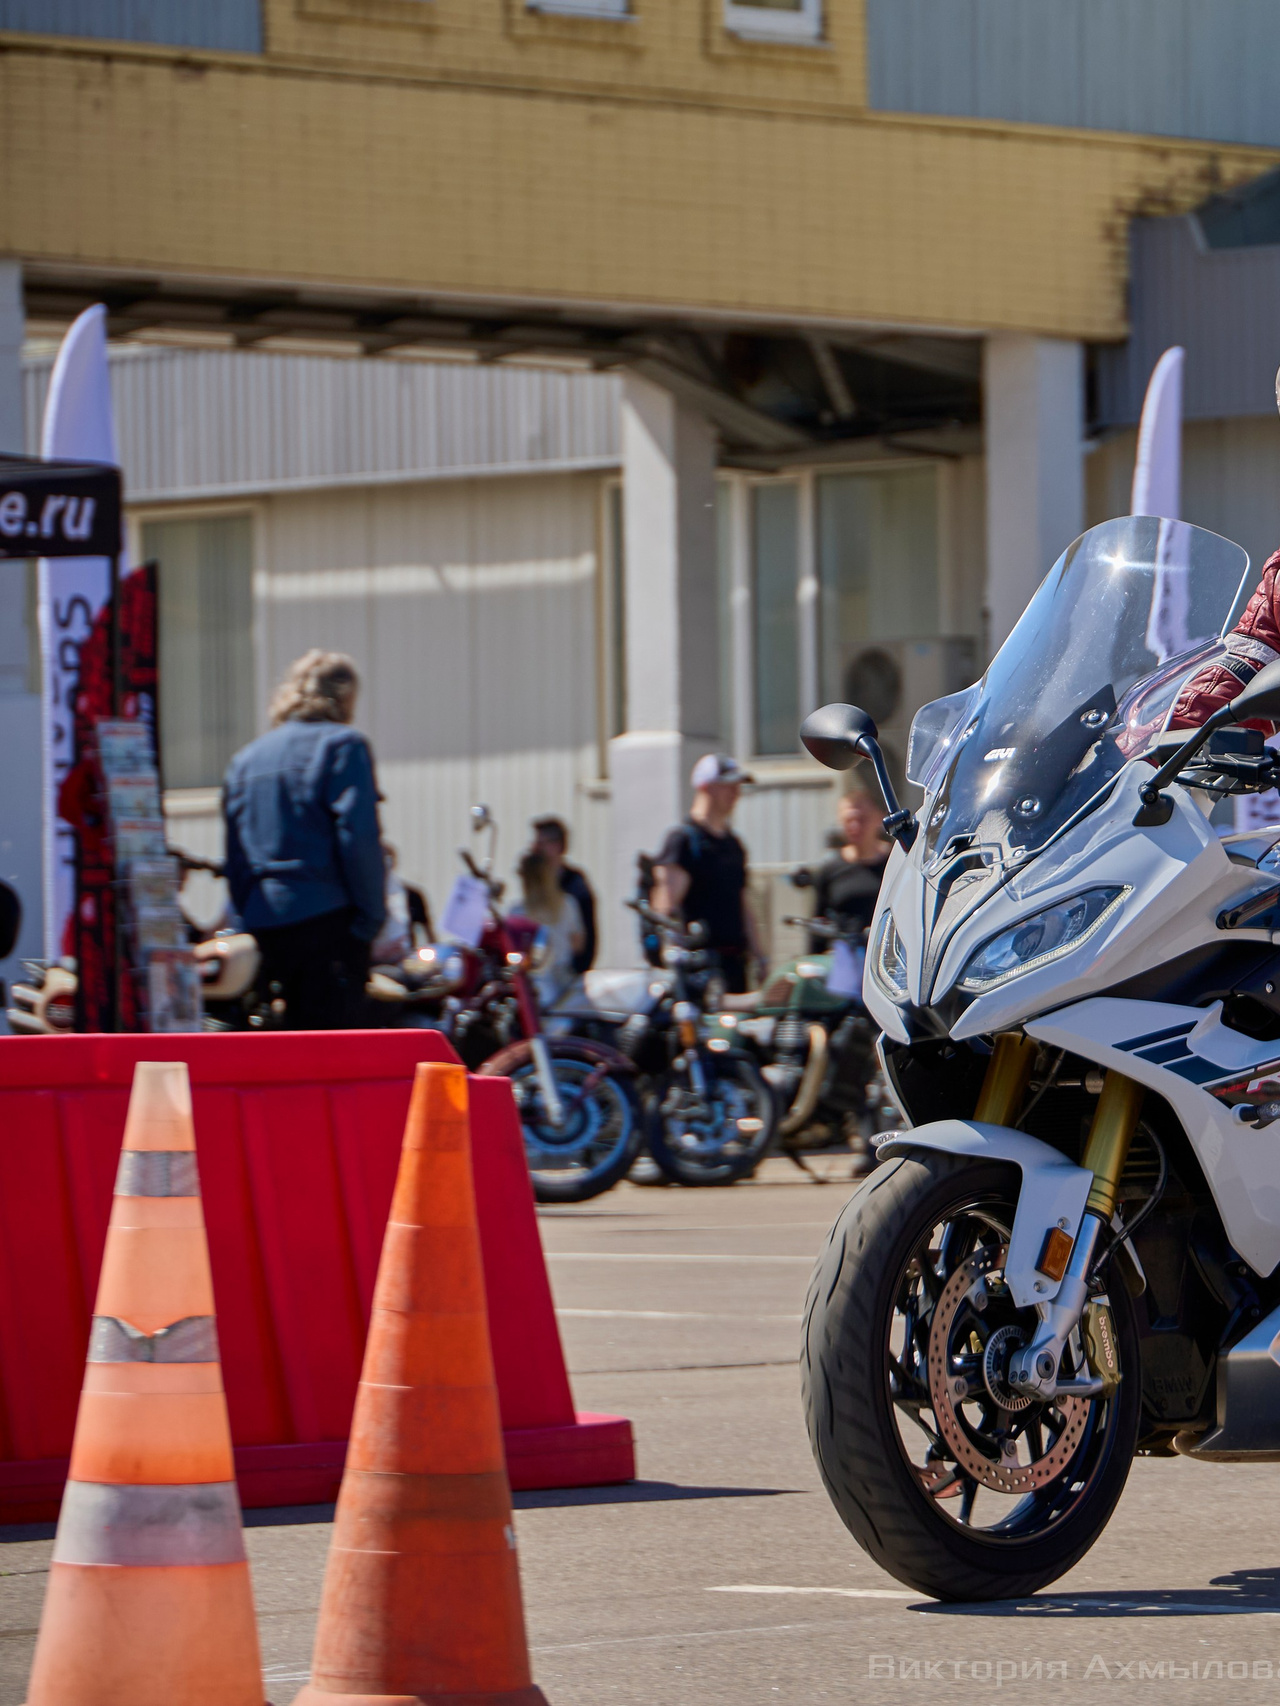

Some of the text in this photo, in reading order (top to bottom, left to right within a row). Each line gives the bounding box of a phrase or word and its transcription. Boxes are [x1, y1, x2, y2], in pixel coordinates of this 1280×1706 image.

[0, 491, 96, 541] e.ru
[983, 747, 1017, 761] GIVI
[1098, 1316, 1114, 1368] brembo
